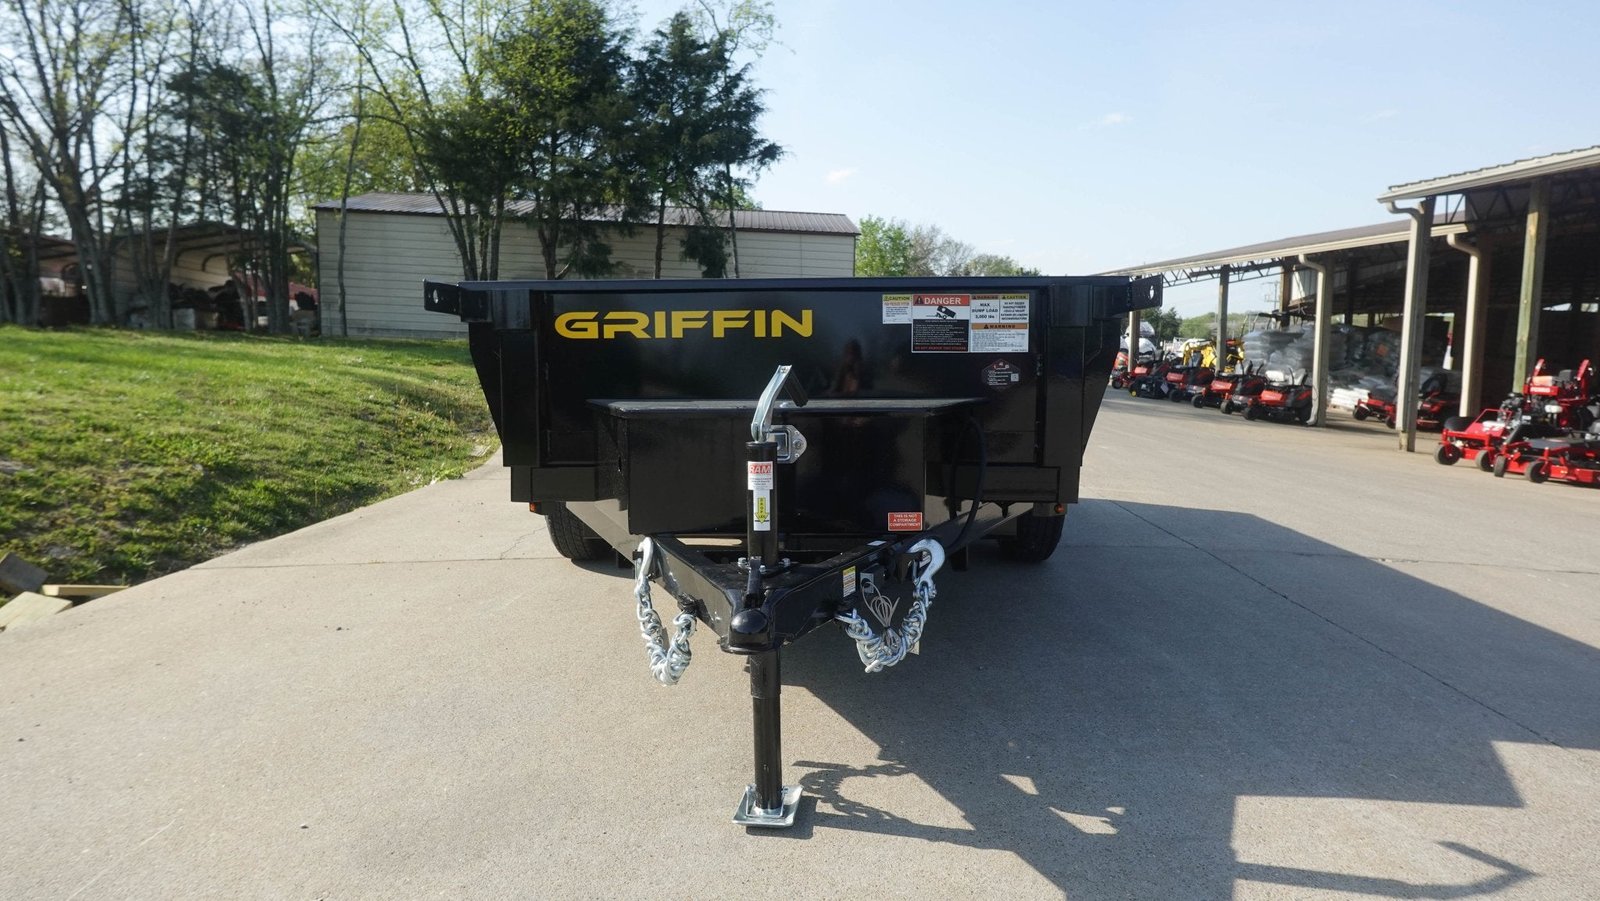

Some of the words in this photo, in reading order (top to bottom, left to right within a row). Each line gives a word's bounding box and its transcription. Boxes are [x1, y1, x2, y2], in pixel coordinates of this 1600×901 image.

[924, 297, 961, 305] DANGER
[554, 309, 813, 339] GRIFFIN
[749, 464, 772, 474] RAM
